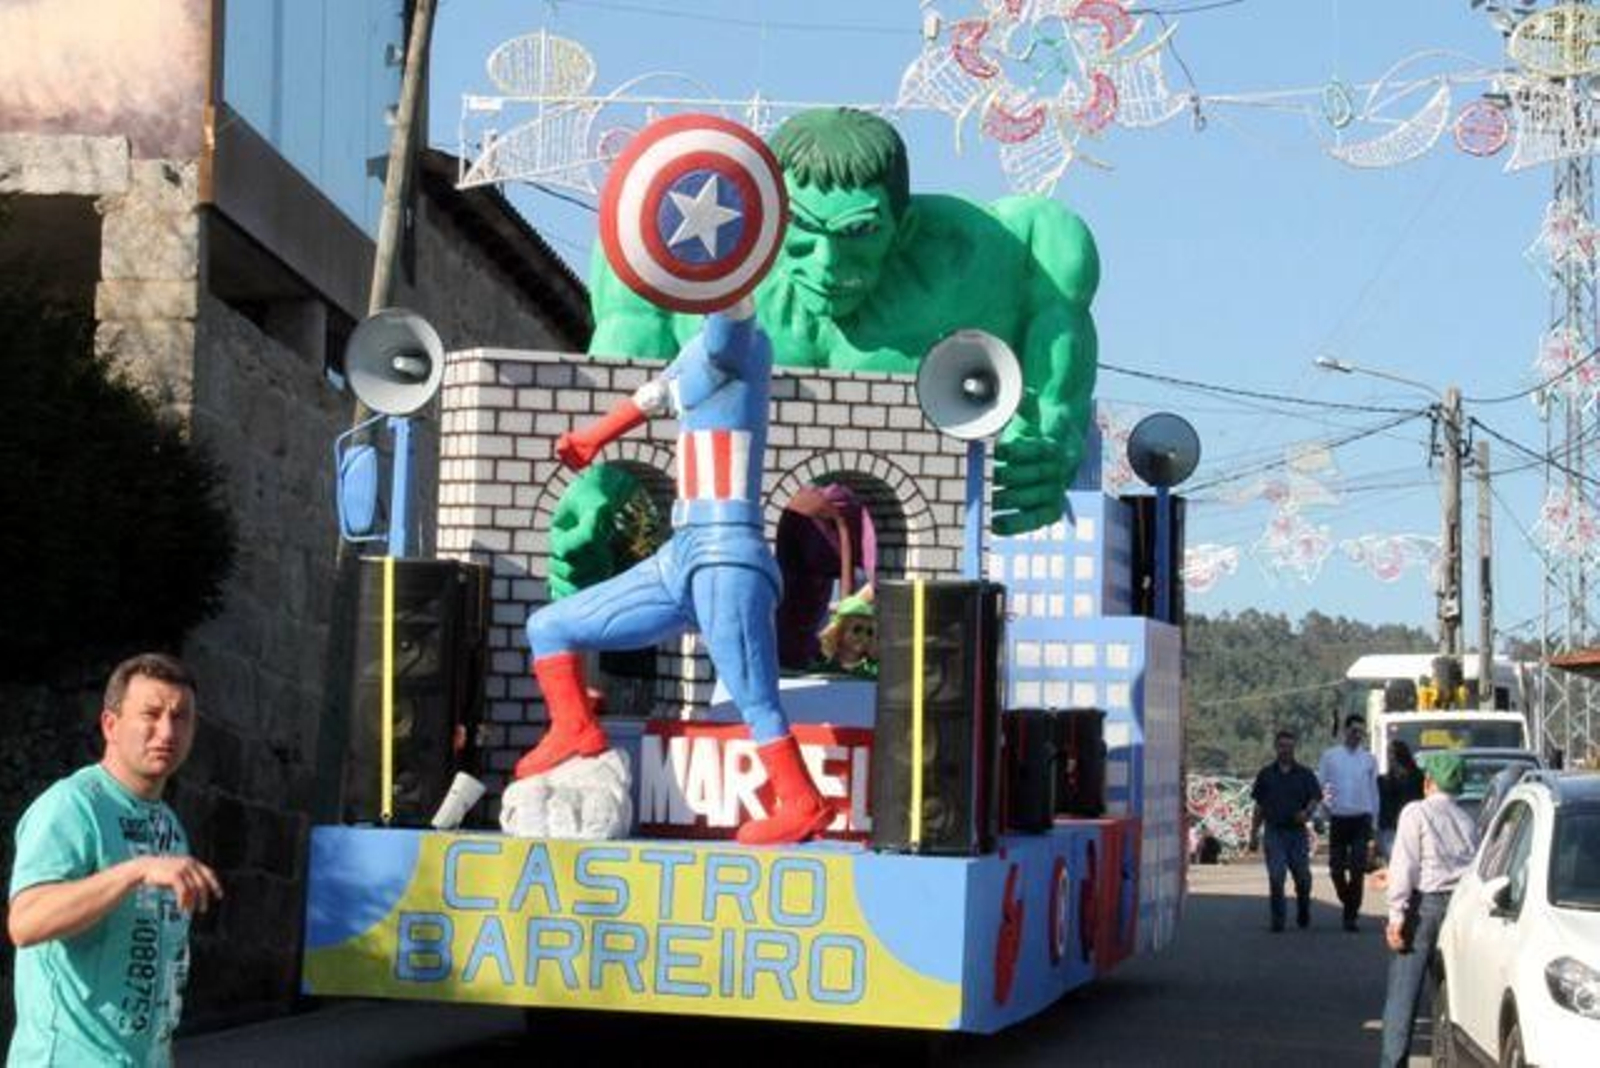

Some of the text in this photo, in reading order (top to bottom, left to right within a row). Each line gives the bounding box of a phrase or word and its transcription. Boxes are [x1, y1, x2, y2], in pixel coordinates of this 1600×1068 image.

[639, 734, 872, 831] MAREL
[441, 839, 827, 927] CASTRO
[394, 911, 867, 1004] BARREIRO
